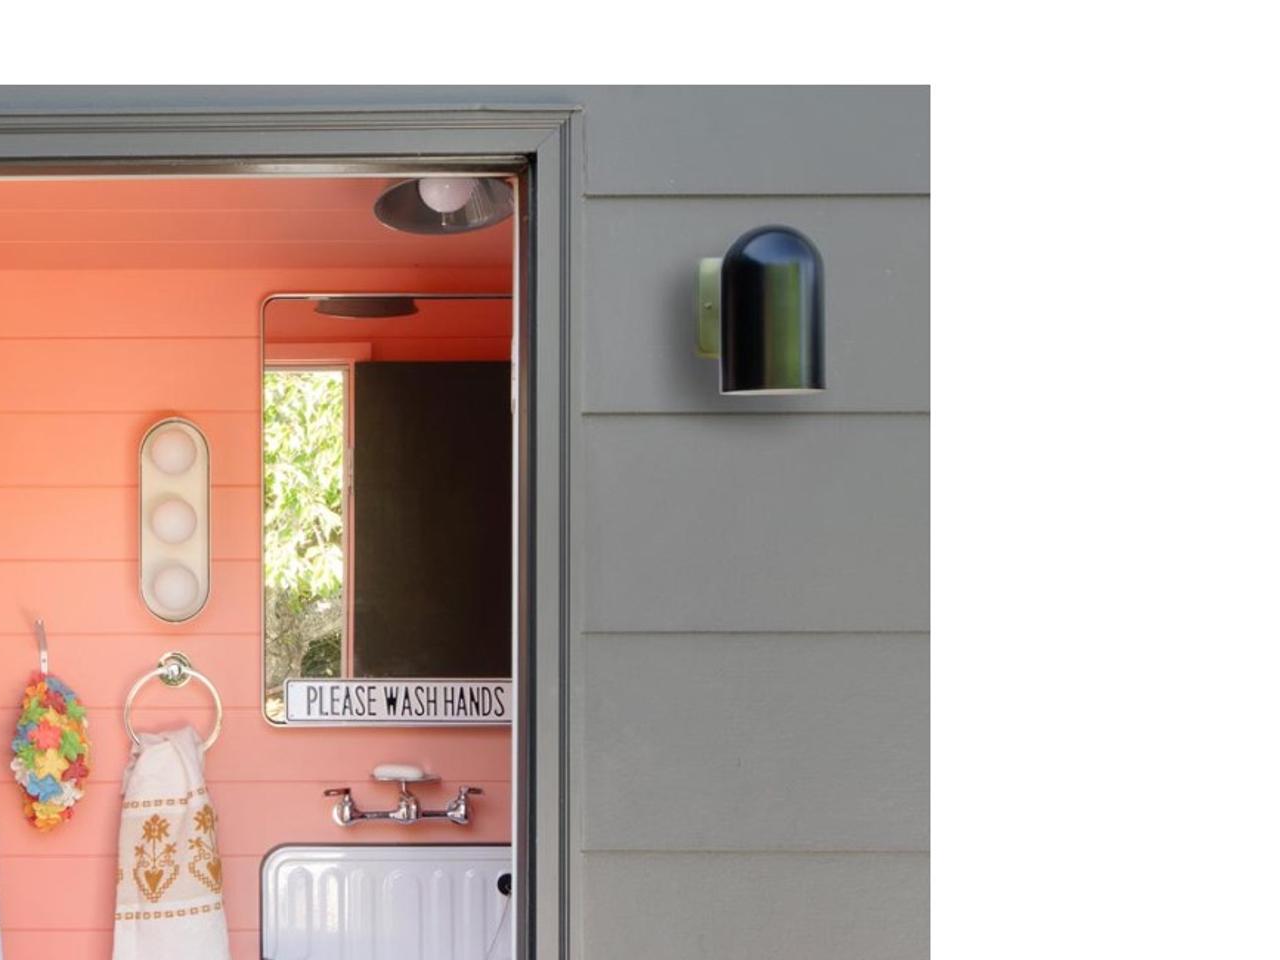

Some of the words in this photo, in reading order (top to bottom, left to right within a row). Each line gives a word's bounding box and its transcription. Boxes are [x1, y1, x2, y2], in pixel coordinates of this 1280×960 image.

[306, 685, 377, 717] PLEASE
[383, 685, 438, 717] WASH
[443, 685, 506, 718] HANDS
